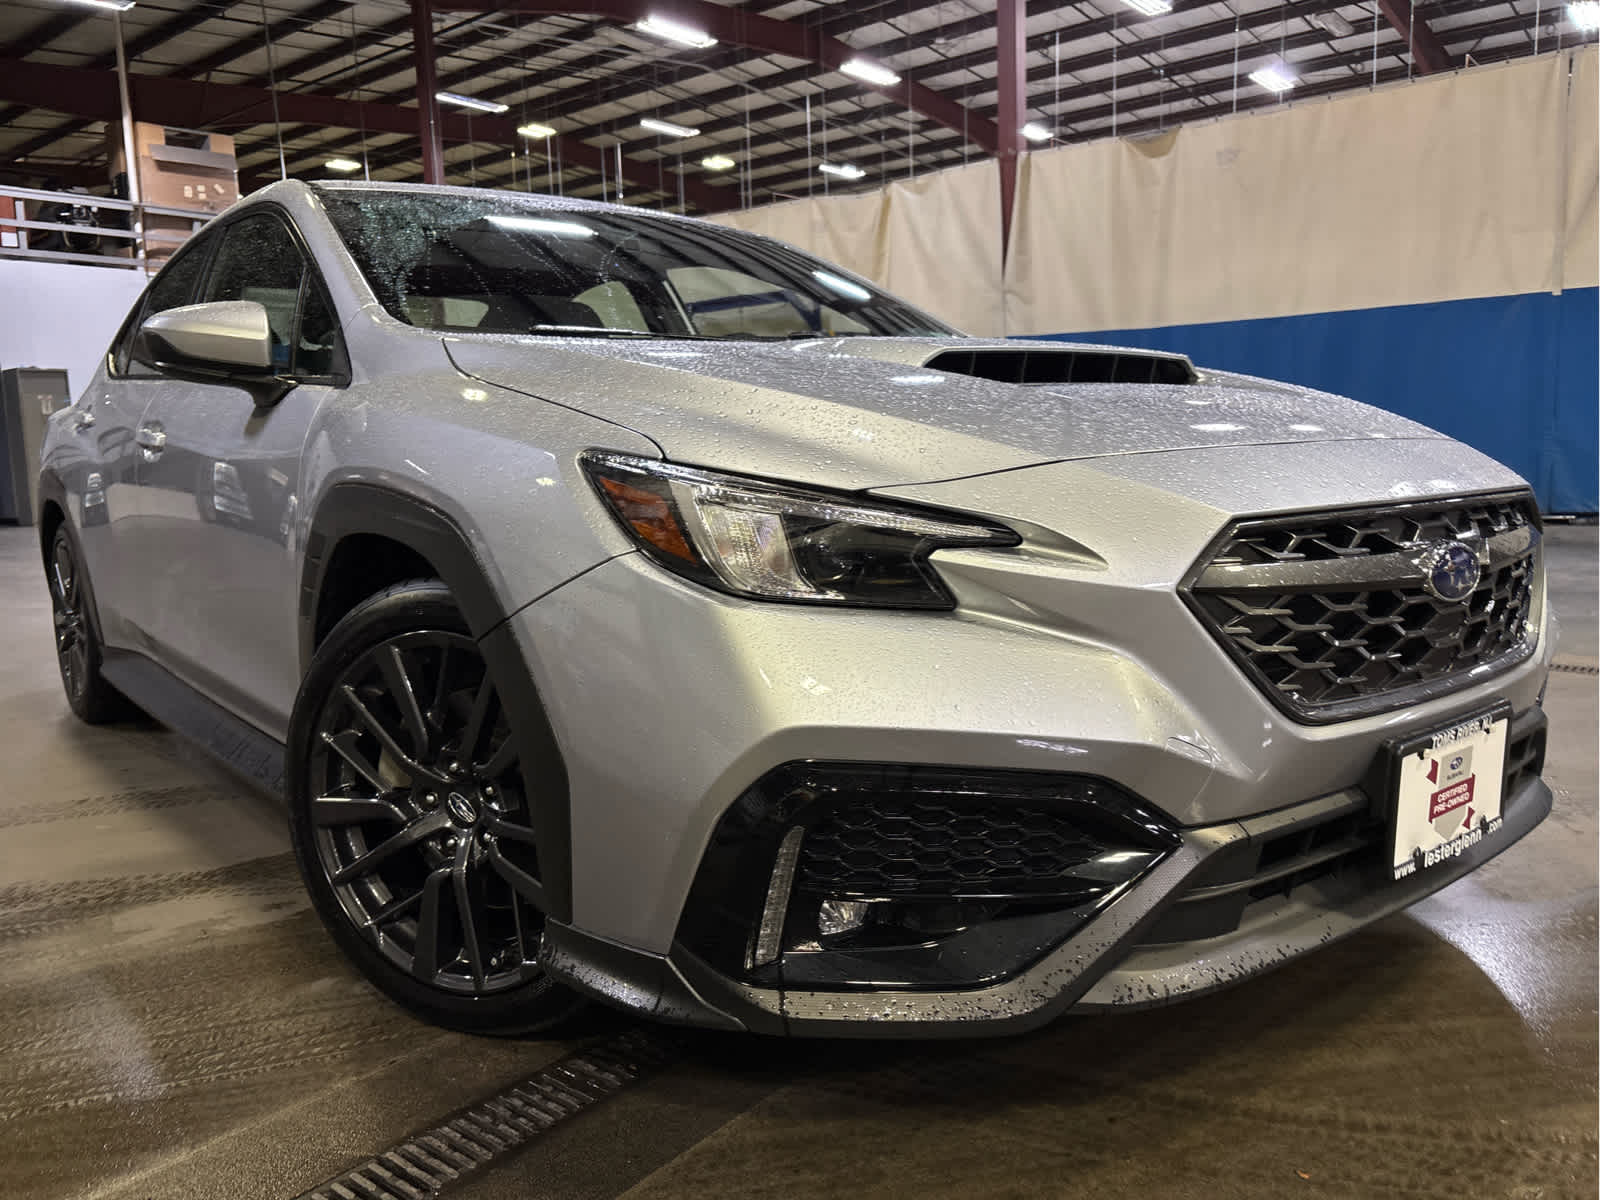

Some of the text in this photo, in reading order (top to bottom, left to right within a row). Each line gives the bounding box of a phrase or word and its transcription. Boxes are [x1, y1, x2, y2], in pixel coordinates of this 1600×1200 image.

[1432, 728, 1457, 749] TOMS
[1433, 791, 1470, 814] PRE-OWNED
[1438, 783, 1468, 803] CERTIFIED
[1424, 828, 1482, 868] lesterglenn
